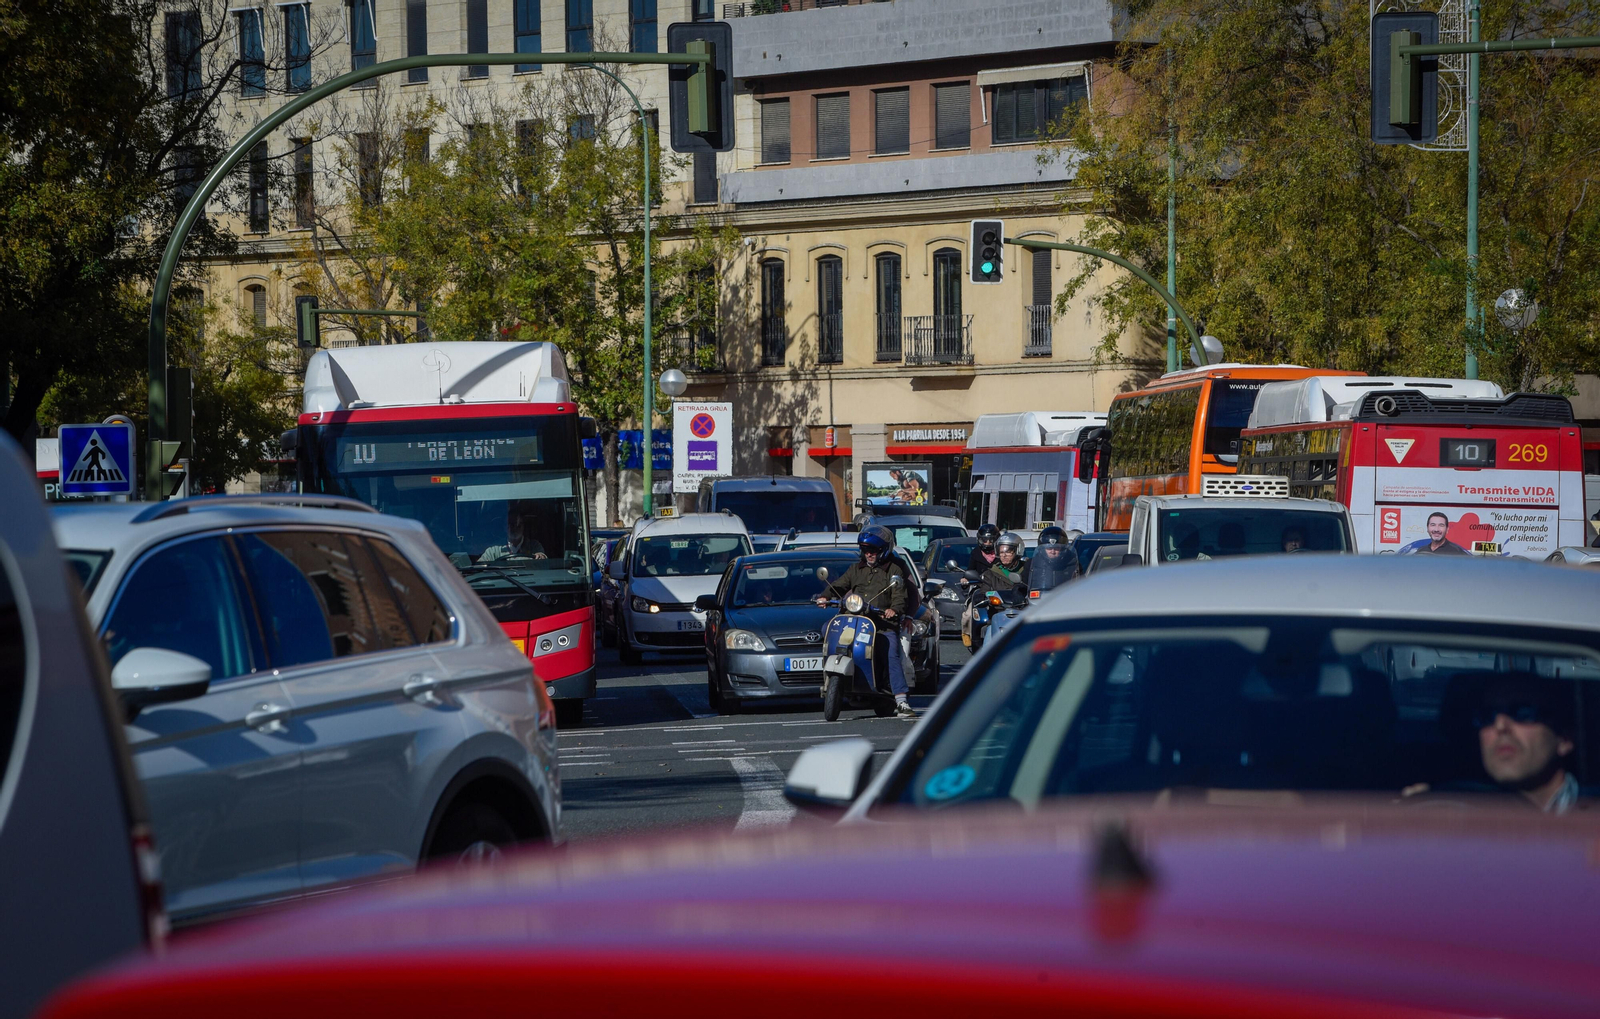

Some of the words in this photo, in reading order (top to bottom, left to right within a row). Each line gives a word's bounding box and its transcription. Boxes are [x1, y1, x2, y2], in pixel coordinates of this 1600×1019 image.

[893, 430, 898, 440] A
[898, 430, 906, 440] LA
[906, 429, 932, 440] PARRILLA
[932, 429, 950, 440] DESDE
[951, 428, 965, 440] 1954
[429, 447, 447, 461] DE
[454, 445, 495, 460] LEON
[1455, 444, 1479, 460] 10
[1508, 443, 1548, 463] 269
[1457, 485, 1520, 495] Transmite
[1522, 486, 1555, 496] VIDA
[661, 508, 673, 516] TAXI
[1503, 512, 1523, 521] lucho
[1523, 514, 1536, 523] por
[1383, 512, 1398, 529] S
[1469, 523, 1508, 531] comunidad
[1510, 524, 1549, 533] rompiendo
[1509, 534, 1516, 542] el
[1481, 543, 1497, 551] TAXI
[683, 621, 703, 630] 1343
[792, 660, 818, 669] 0017
